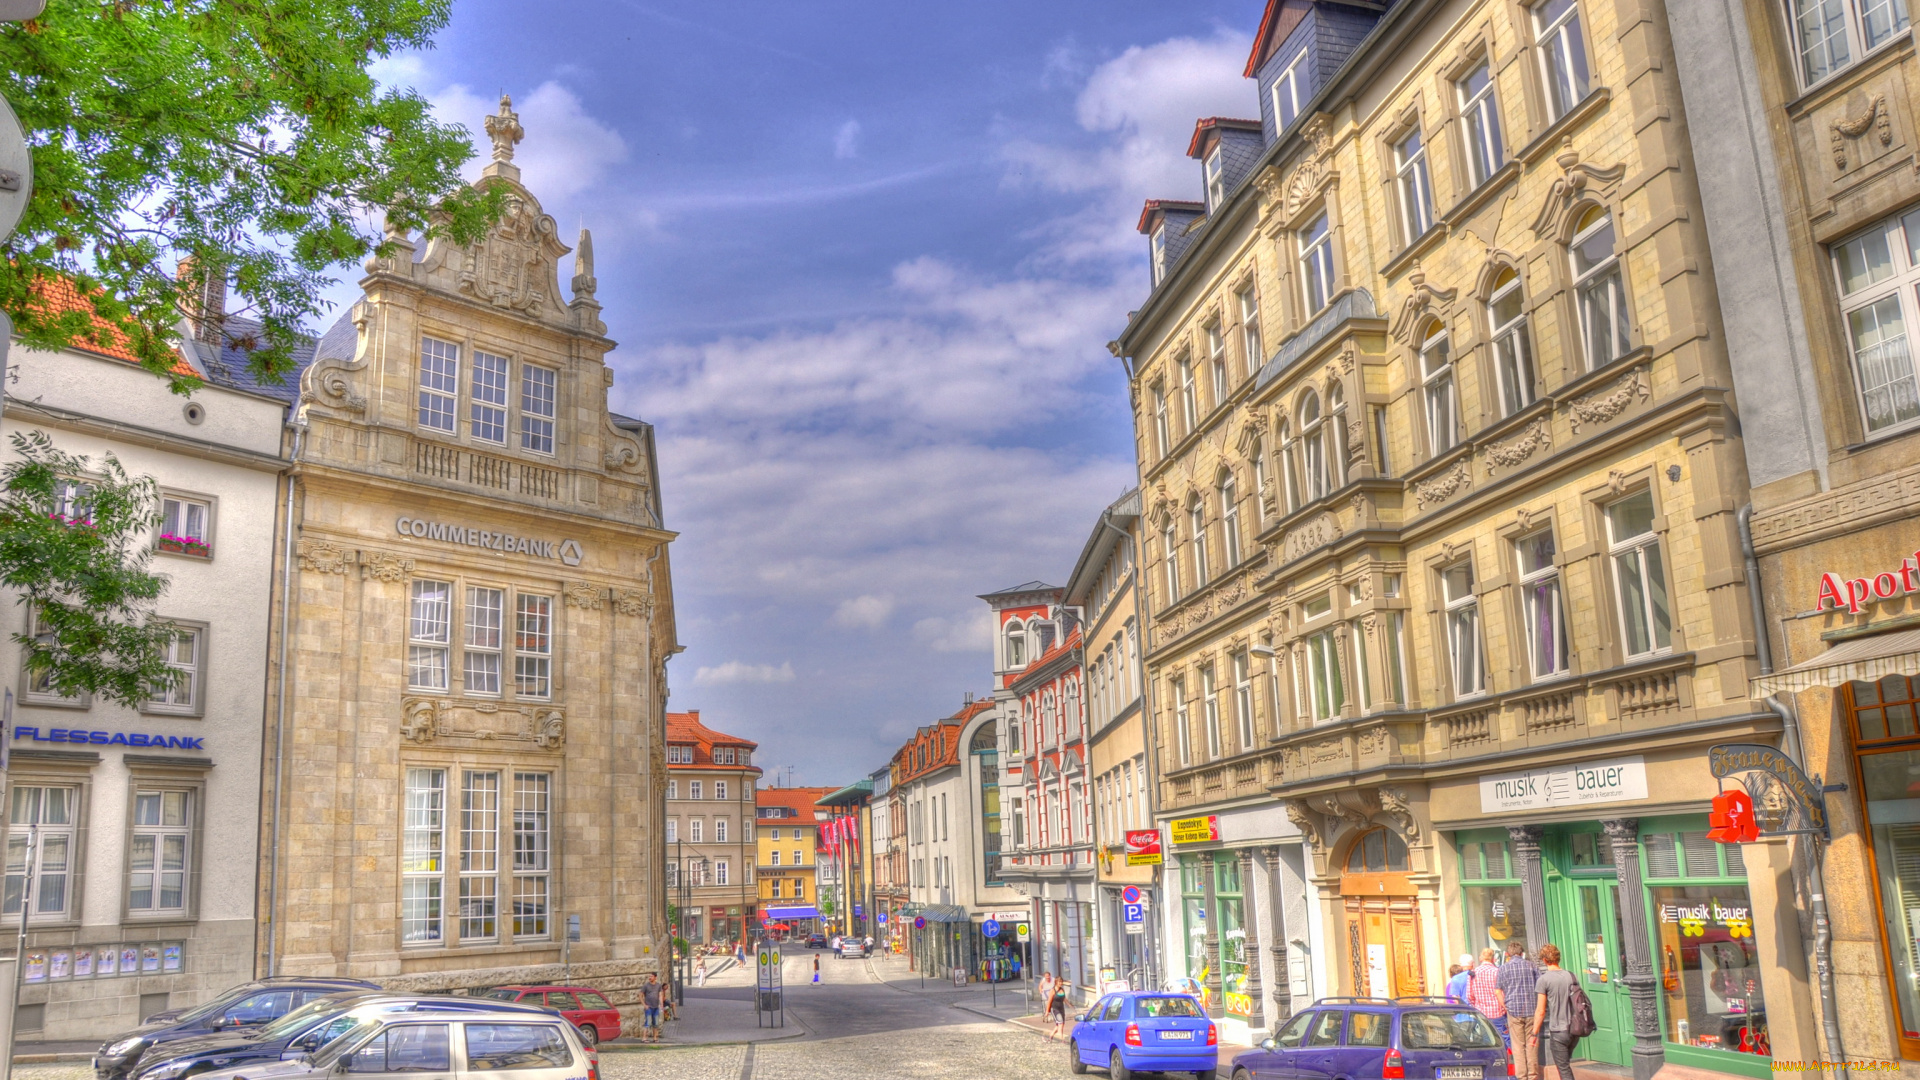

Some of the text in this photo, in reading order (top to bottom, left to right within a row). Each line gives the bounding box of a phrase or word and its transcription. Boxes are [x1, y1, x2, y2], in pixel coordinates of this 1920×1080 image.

[396, 516, 556, 559] COMMERZBANK
[14, 726, 205, 750] FLESSABANK
[1495, 766, 1624, 799] musik bauer
[1711, 746, 1825, 828] Frauenberg
[1177, 819, 1202, 830] Kapadokya
[1198, 832, 1208, 840] Haus
[1128, 906, 1139, 921] P
[1677, 903, 1748, 920] musik bauer
[1461, 1068, 1471, 1077] AG
[1473, 1068, 1481, 1077] 32
